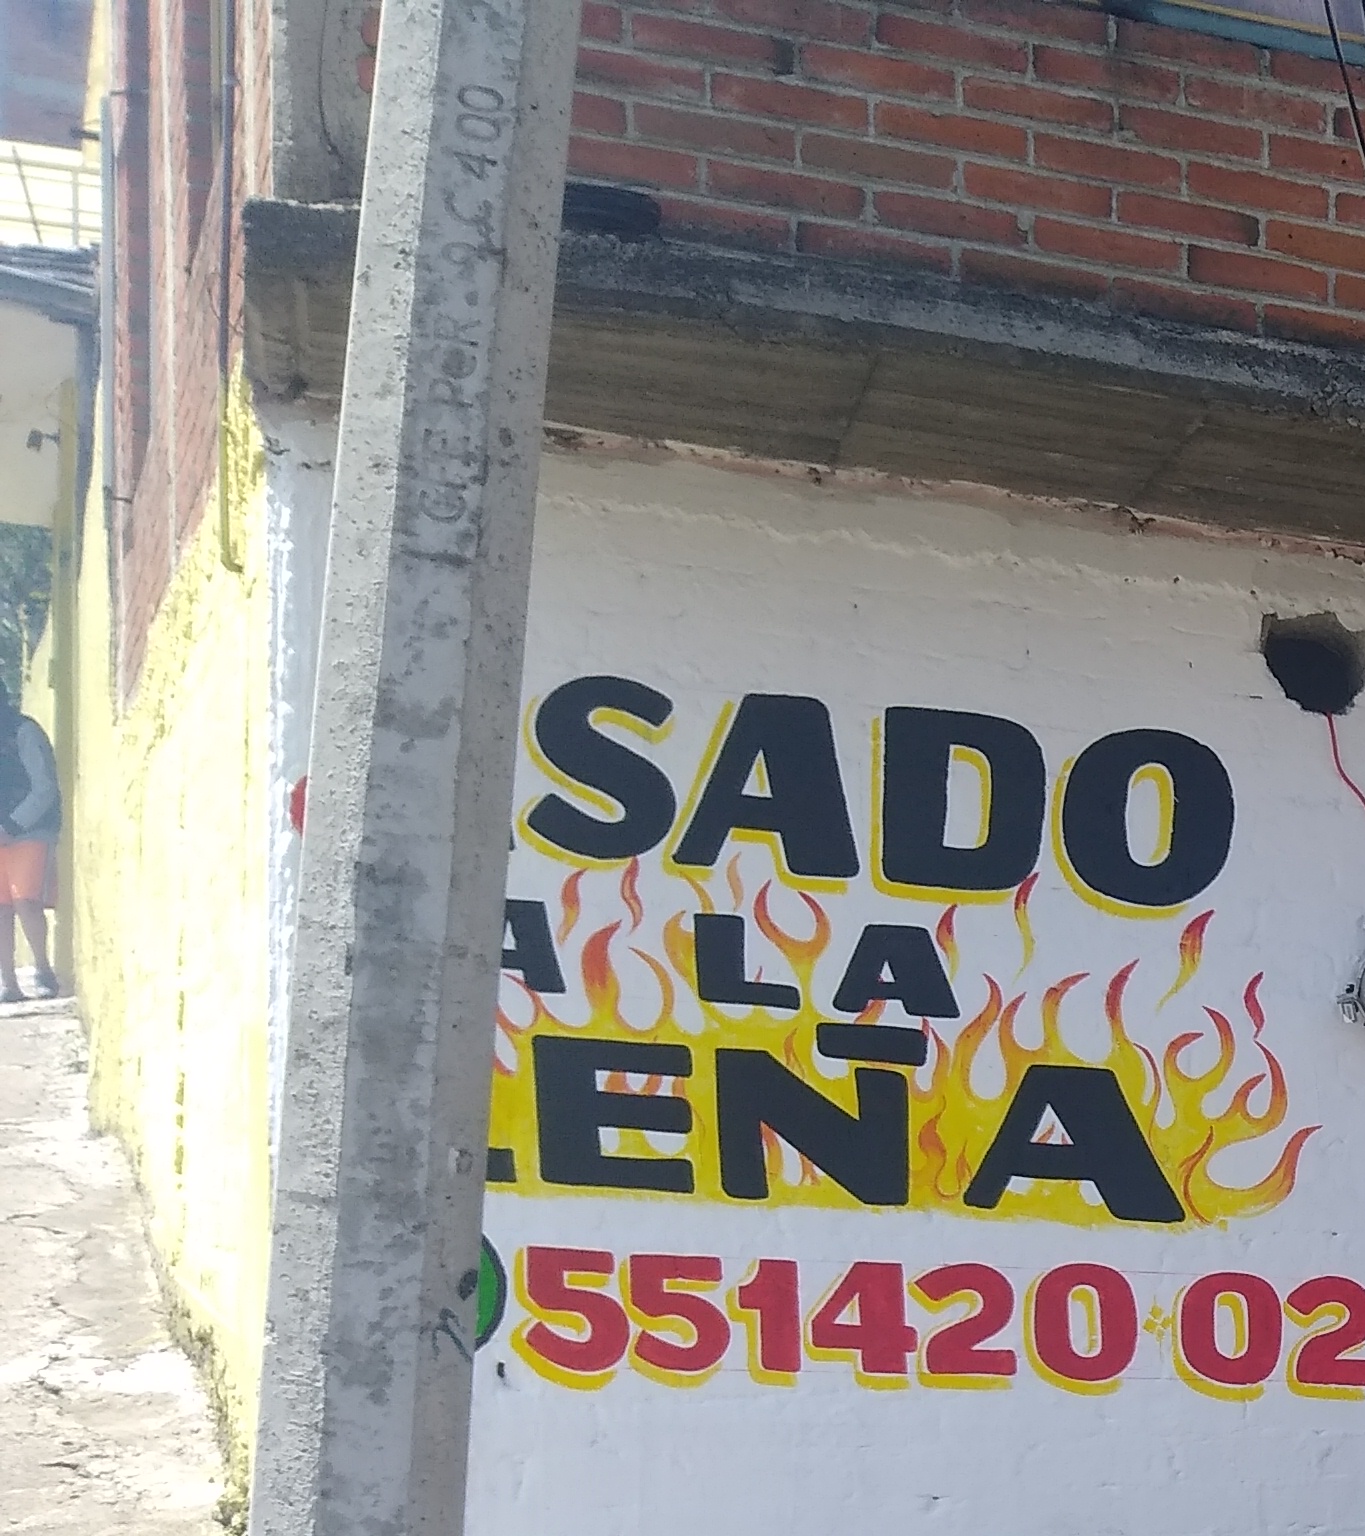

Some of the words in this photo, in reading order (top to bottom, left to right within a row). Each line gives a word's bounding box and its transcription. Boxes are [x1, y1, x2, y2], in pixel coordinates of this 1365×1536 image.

[508, 675, 1236, 908] SADO
[693, 912, 961, 1020] LA
[487, 1022, 1186, 1223] EÑA
